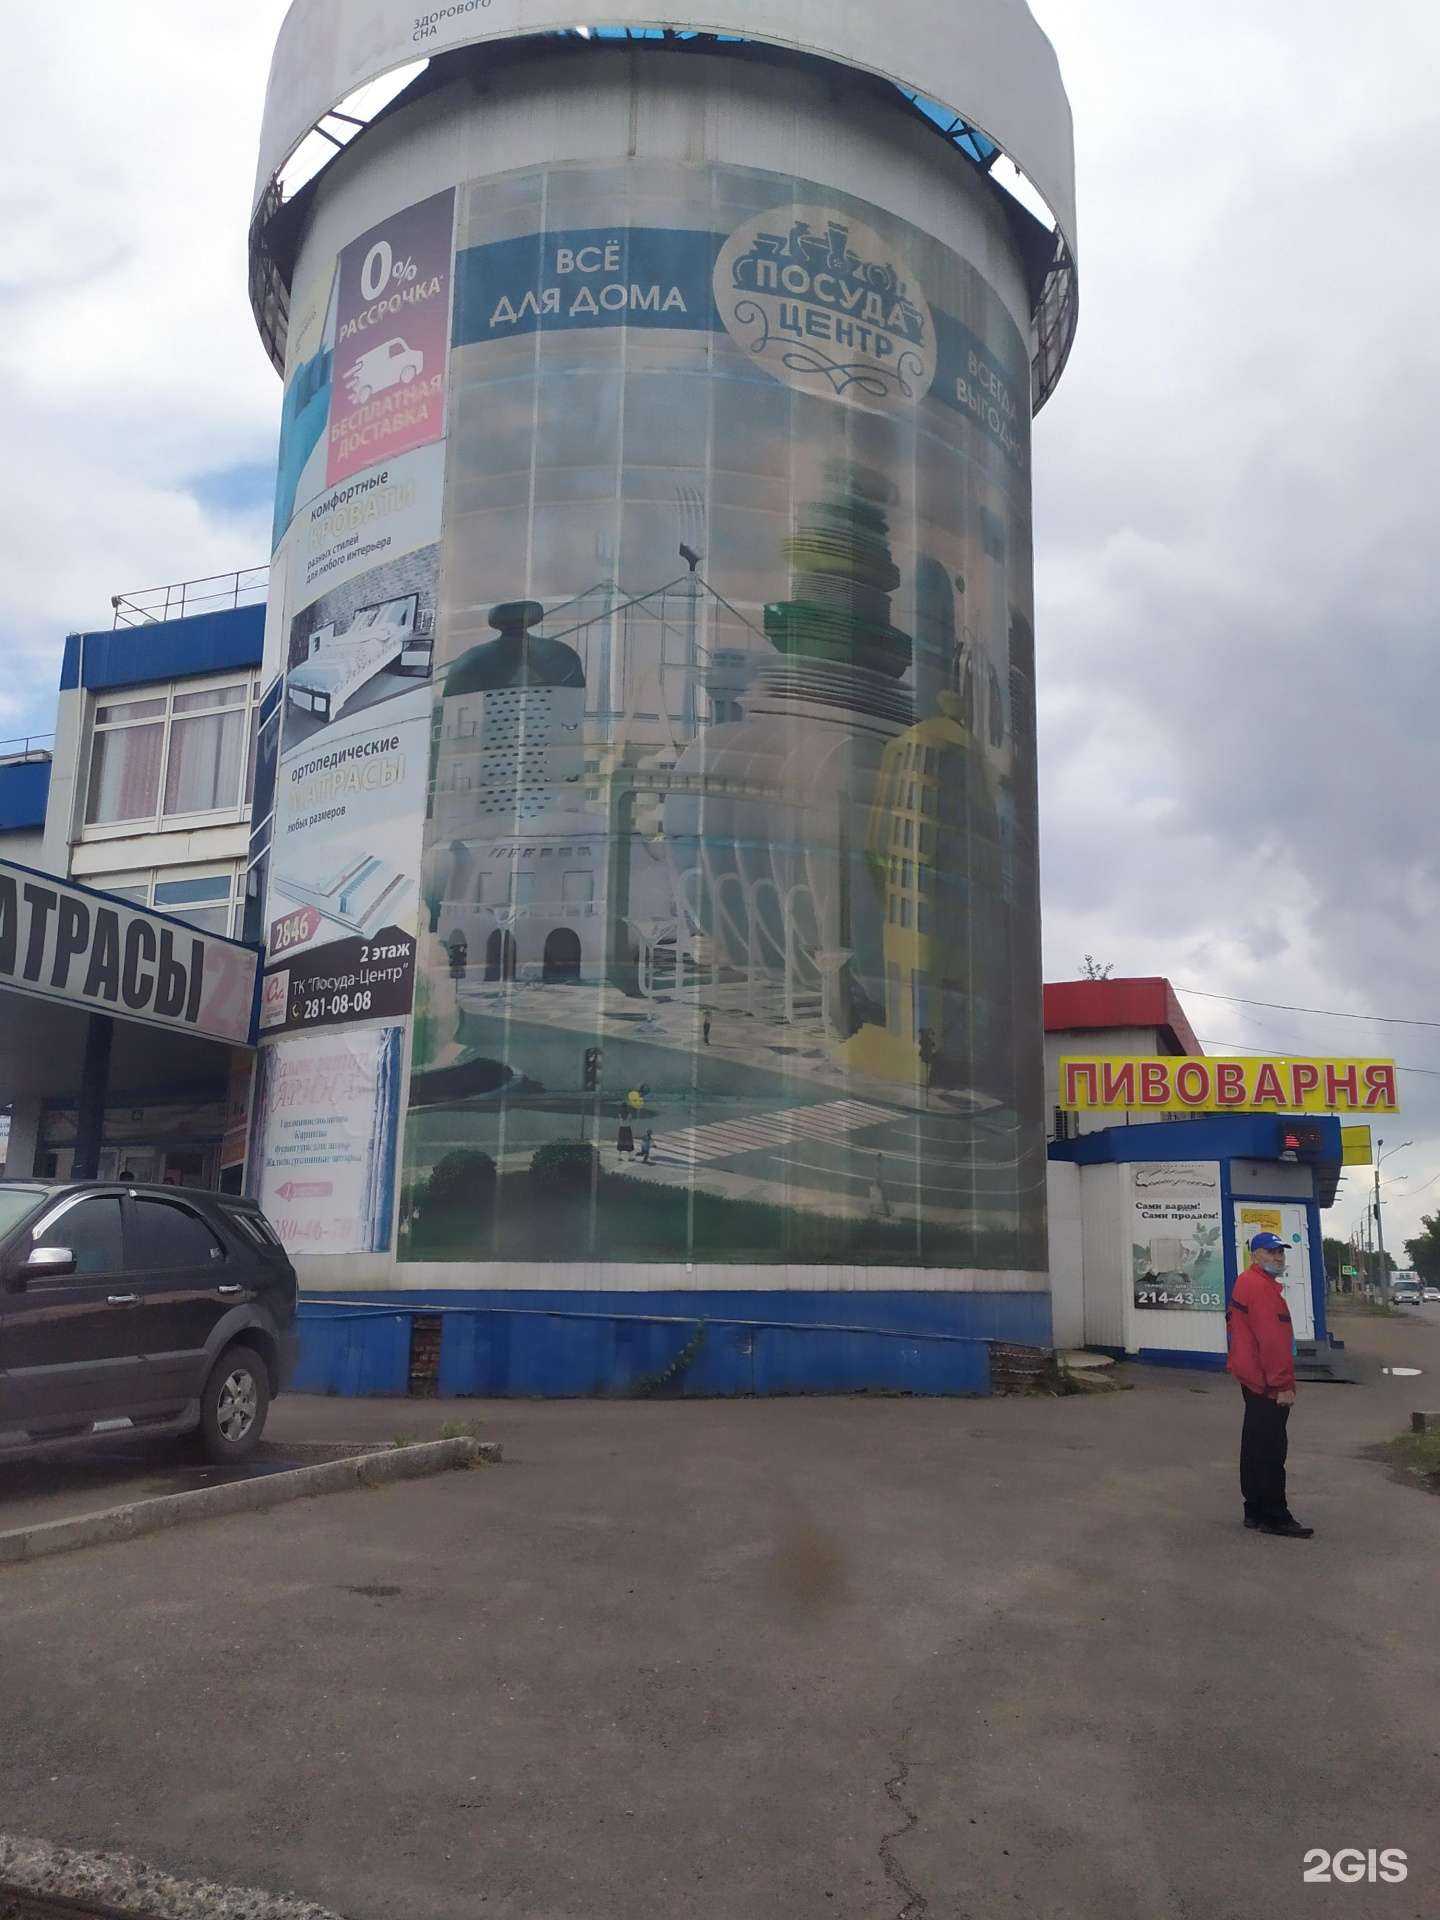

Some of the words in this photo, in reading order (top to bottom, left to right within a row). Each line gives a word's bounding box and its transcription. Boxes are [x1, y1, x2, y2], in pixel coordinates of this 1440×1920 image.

[412, 25, 437, 41] СНА
[413, 0, 491, 29] ЗДОРОВОГО
[361, 240, 417, 301] 0%
[556, 239, 621, 274] ВСЁ
[489, 287, 561, 328] ДЛЯ
[569, 283, 687, 317] ДОМА
[756, 258, 909, 334] ПОСУДА
[778, 302, 894, 359] ЦЕНТР
[310, 471, 388, 522] комфортные
[305, 570, 319, 585] для
[319, 554, 346, 576] любого
[346, 537, 392, 561] интерьера
[307, 550, 332, 572] разных
[332, 533, 359, 556] стилей
[291, 736, 400, 784] ортопедические
[288, 753, 407, 809] МАТРАСЫ
[287, 817, 309, 833] любых
[309, 806, 346, 828] размеров
[274, 912, 309, 950] 2846
[360, 945, 369, 963] 2
[371, 943, 410, 961] этаж
[292, 979, 305, 996] ТК
[304, 990, 372, 1019] 281-08-08
[1064, 1061, 1398, 1108] ПИВОВАРНЯ
[1135, 1202, 1162, 1210] Сами
[1165, 1202, 1201, 1213] варим!
[1141, 1211, 1169, 1220] Сами
[1137, 1291, 1221, 1306] 214-43-03
